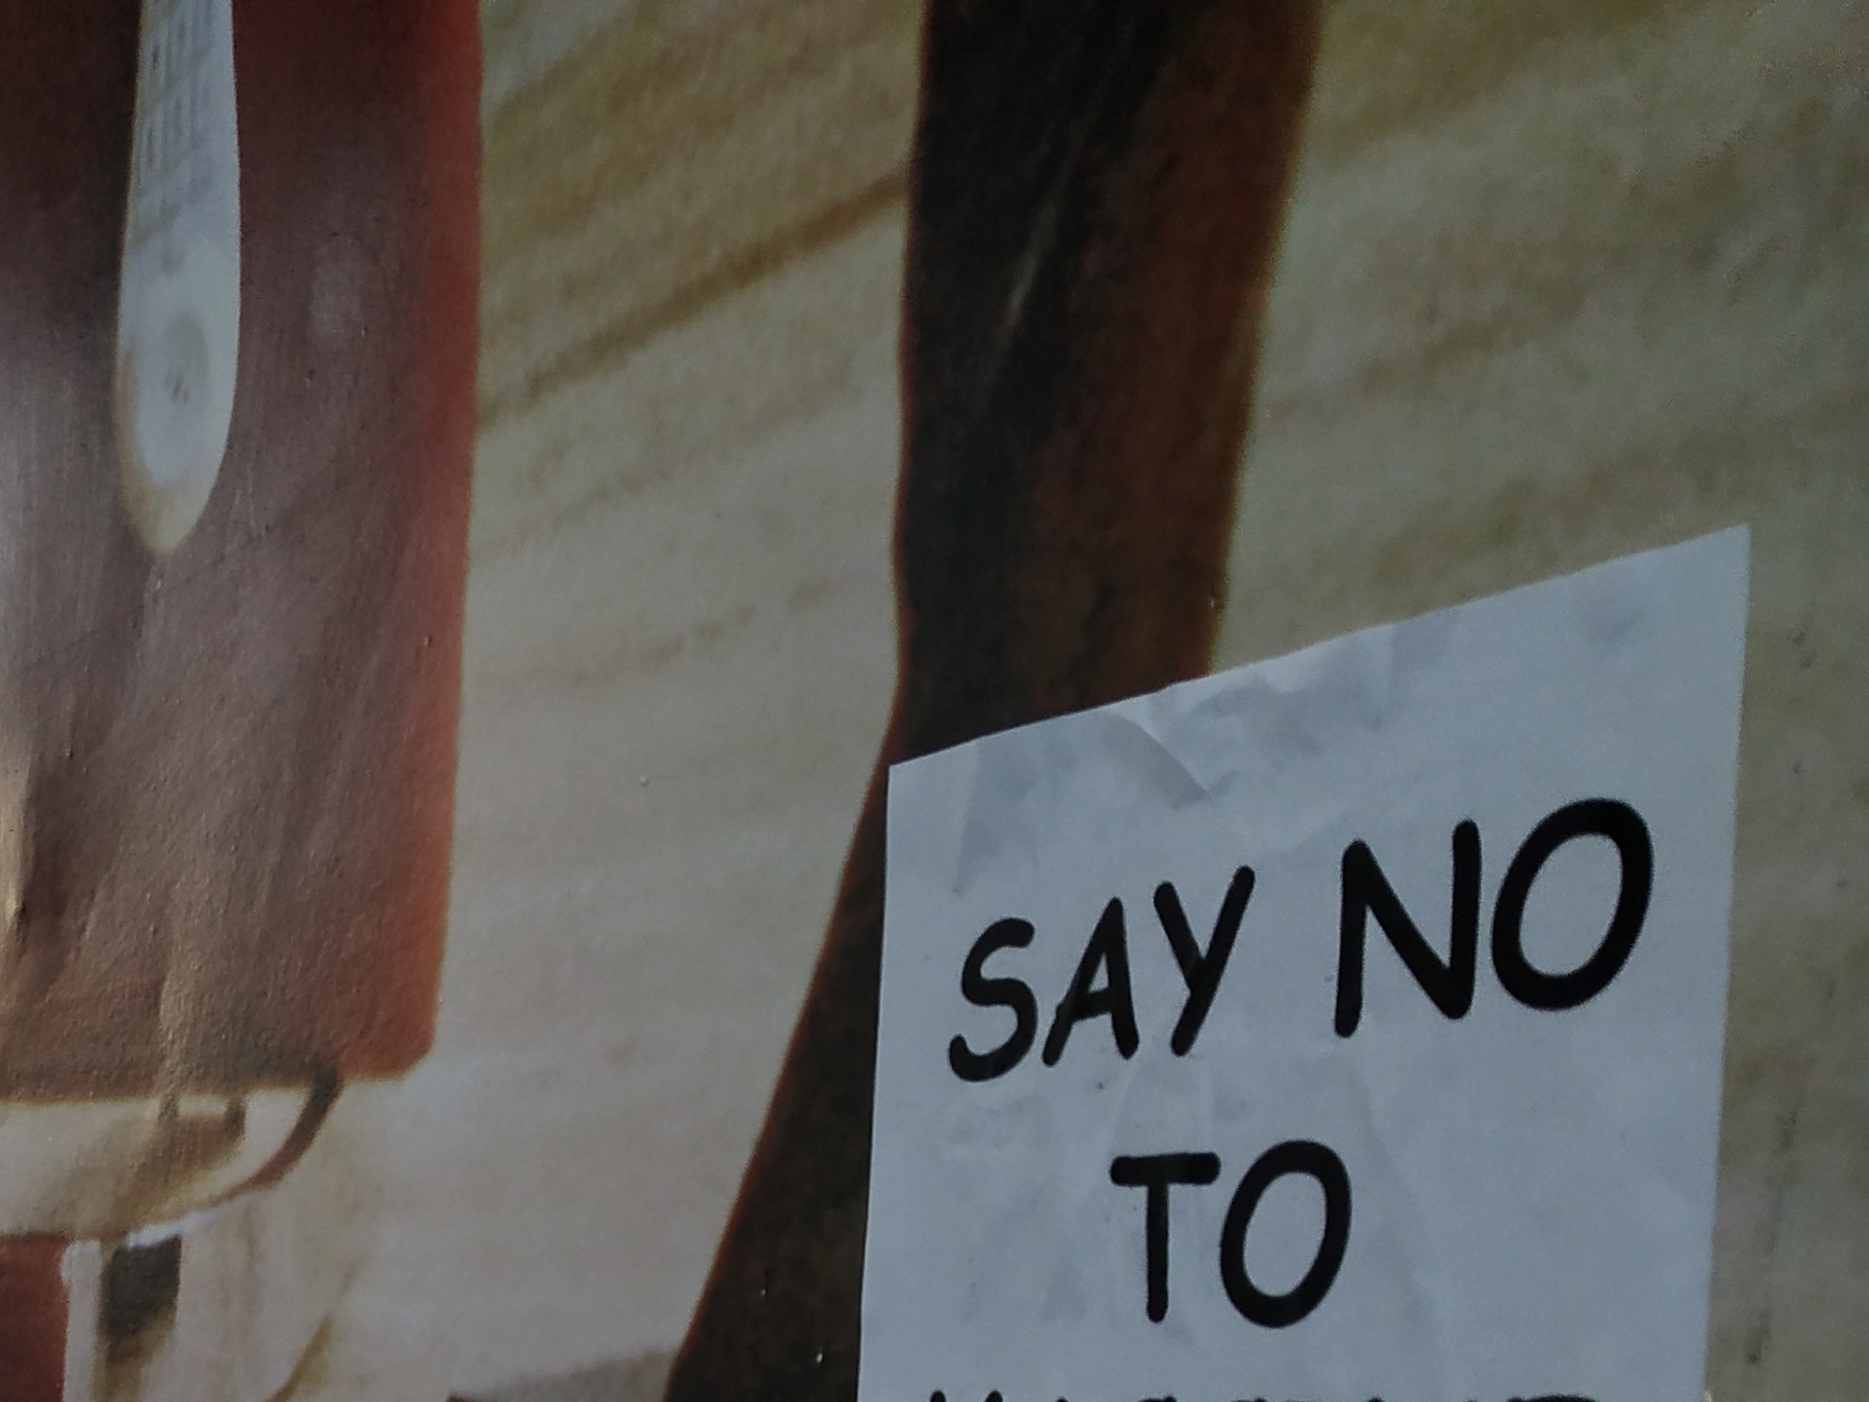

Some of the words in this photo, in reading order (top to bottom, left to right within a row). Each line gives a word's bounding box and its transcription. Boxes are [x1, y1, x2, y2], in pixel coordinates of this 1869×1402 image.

[948, 865, 1256, 1084] SAY
[1333, 797, 1656, 1039] NO
[1109, 1139, 1353, 1330] TO
